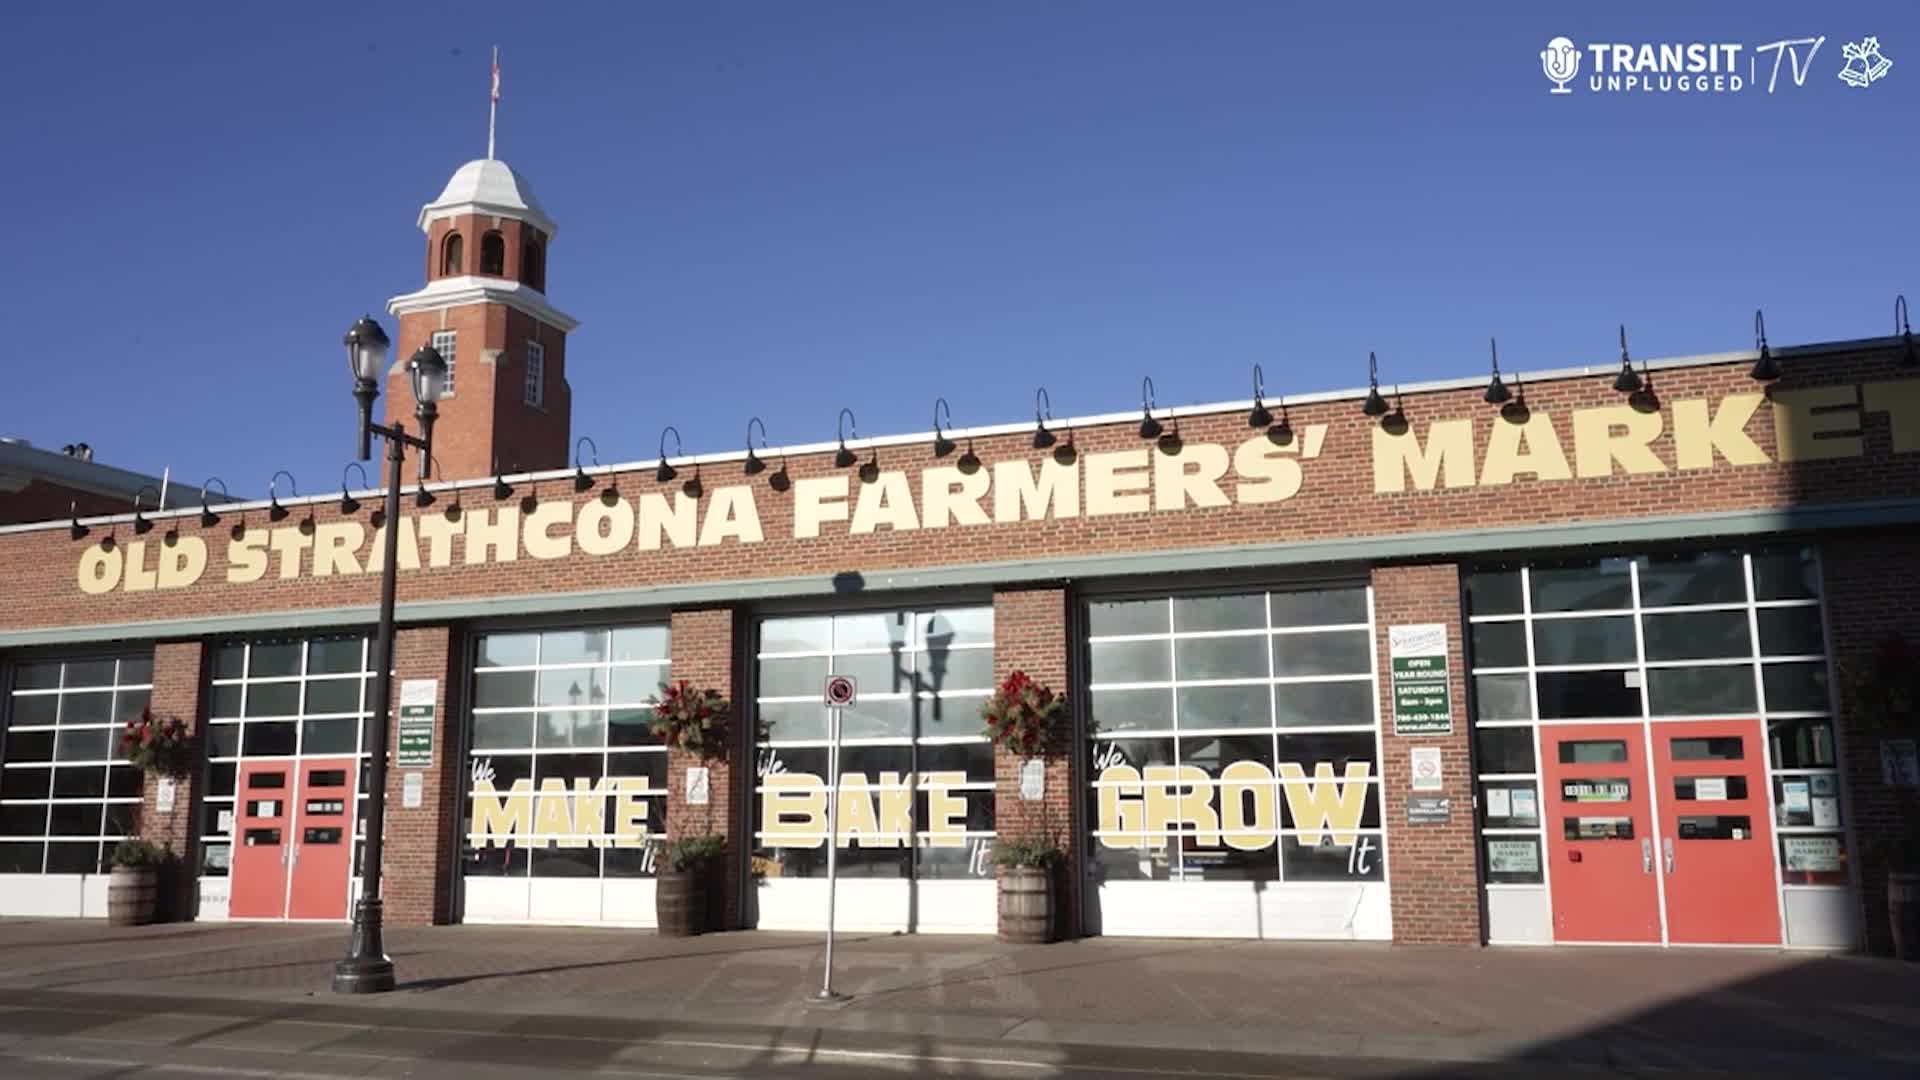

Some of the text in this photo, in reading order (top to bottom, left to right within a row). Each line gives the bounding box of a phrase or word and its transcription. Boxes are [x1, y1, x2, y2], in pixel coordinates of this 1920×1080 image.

[77, 536, 208, 594] OLD
[227, 485, 765, 583] STRATHCONA
[794, 425, 1329, 539] FARMERS'
[1394, 670, 1447, 679] YEAR ROUND
[1407, 659, 1431, 668] OPEN
[1398, 686, 1445, 695] SATURDAYS
[471, 757, 496, 782] We
[756, 750, 788, 778] We
[1093, 741, 1126, 770] We
[470, 775, 650, 849] MAKE
[761, 770, 969, 849] BAKE
[1096, 760, 1371, 851] GROW
[968, 839, 992, 876] It
[1348, 837, 1377, 875] It
